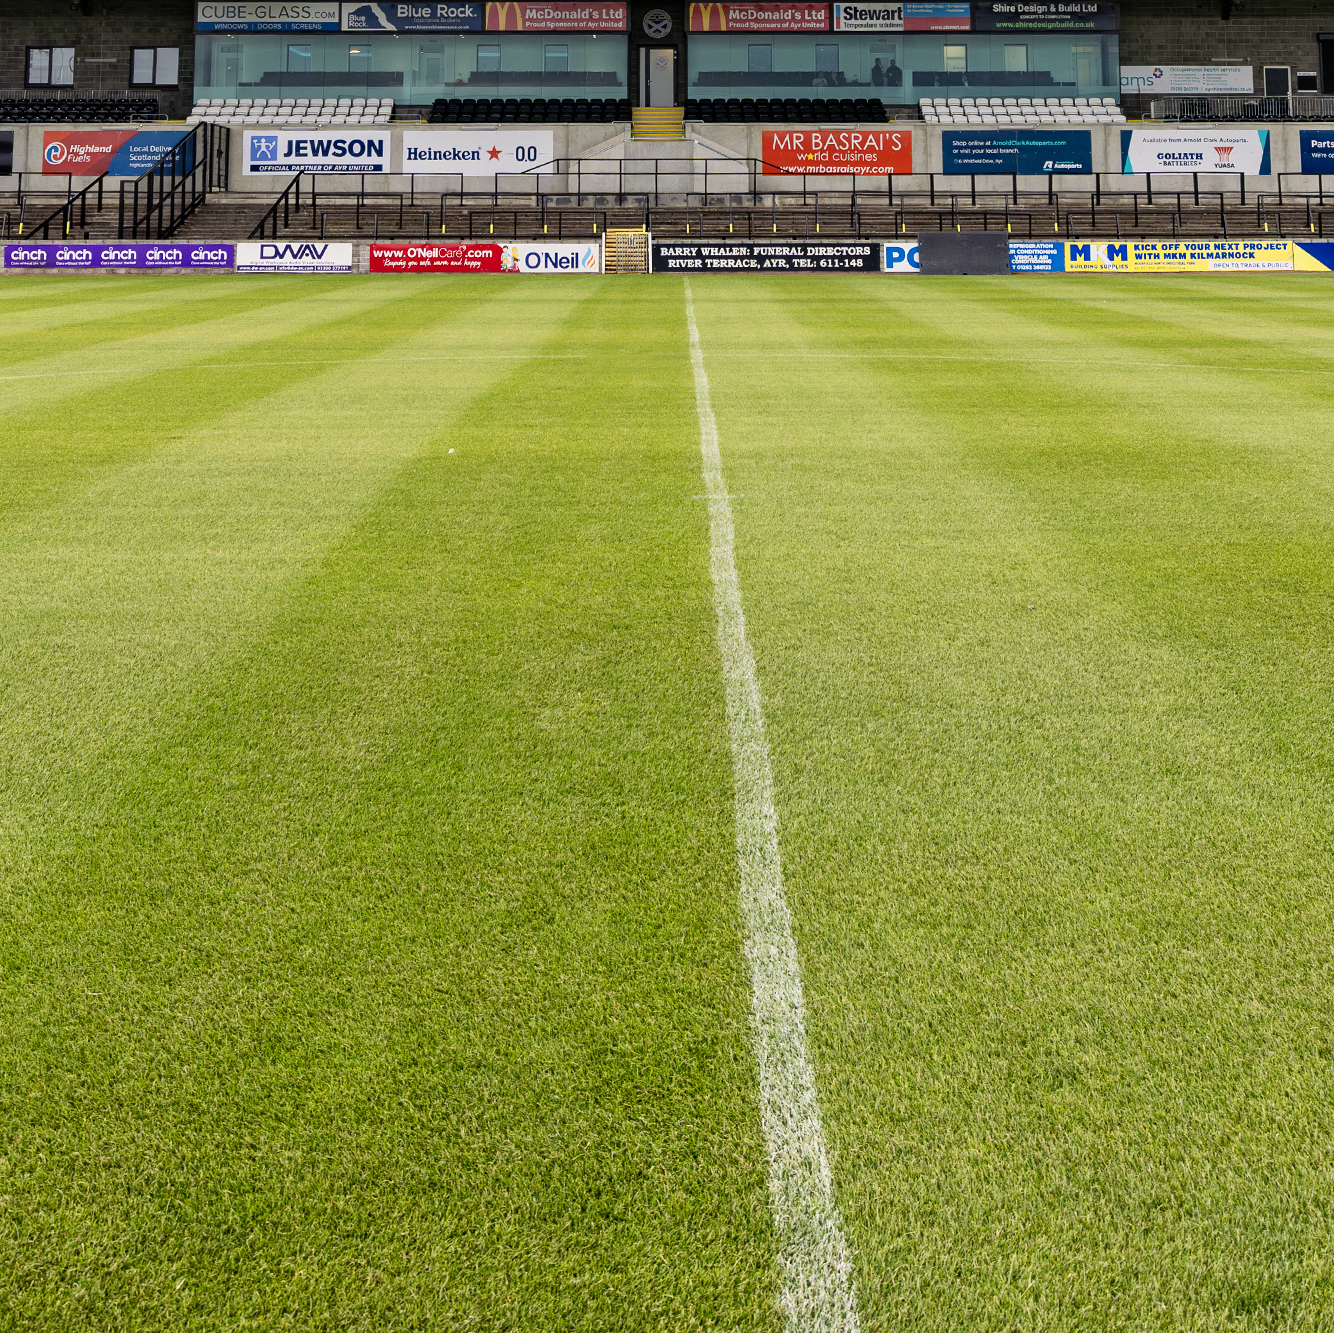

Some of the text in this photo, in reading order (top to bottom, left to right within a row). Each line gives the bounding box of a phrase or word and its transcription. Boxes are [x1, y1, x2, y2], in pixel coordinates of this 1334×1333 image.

[397, 5, 431, 18] Blue
[525, 8, 623, 19] McDonald's Ltd
[728, 9, 825, 20] McDonald's Ltd
[843, 6, 903, 21] Stewart
[992, 4, 1098, 14] Shire Design & Build Ltd
[349, 14, 366, 22] Blue
[546, 21, 578, 29] Sponsors
[587, 21, 599, 29] Ayr
[843, 22, 876, 30] Temperature
[1120, 76, 1154, 87] ams
[772, 133, 902, 151] MR BASRAI'S
[70, 144, 112, 155] Highland
[283, 139, 384, 158] JEWSON
[515, 145, 538, 162] 0.0
[67, 154, 91, 163] Fuels
[129, 153, 161, 161] Scotland
[1156, 152, 1204, 161] GOLIATH
[779, 163, 895, 175] www.mrbasraisayr.com
[1053, 163, 1082, 171] Autoparts
[259, 244, 329, 260] DWAV
[660, 247, 871, 257] BARRY WHALEN: FUNERAL DIRECTORS
[1134, 243, 1288, 252] KICK OFF YOUR NEXT PROJECT
[10, 247, 47, 261] cinch
[55, 247, 93, 261] cinch
[100, 247, 137, 261] cinch
[145, 247, 183, 261] cinch
[190, 247, 228, 261] cinch
[1069, 244, 1129, 269] MKM
[1134, 251, 1256, 261] WITH MKM KILMARNOCK
[525, 252, 579, 270] O'Neil
[667, 259, 864, 270] RIVER TERRACE, AYR, TEL: 611-148
